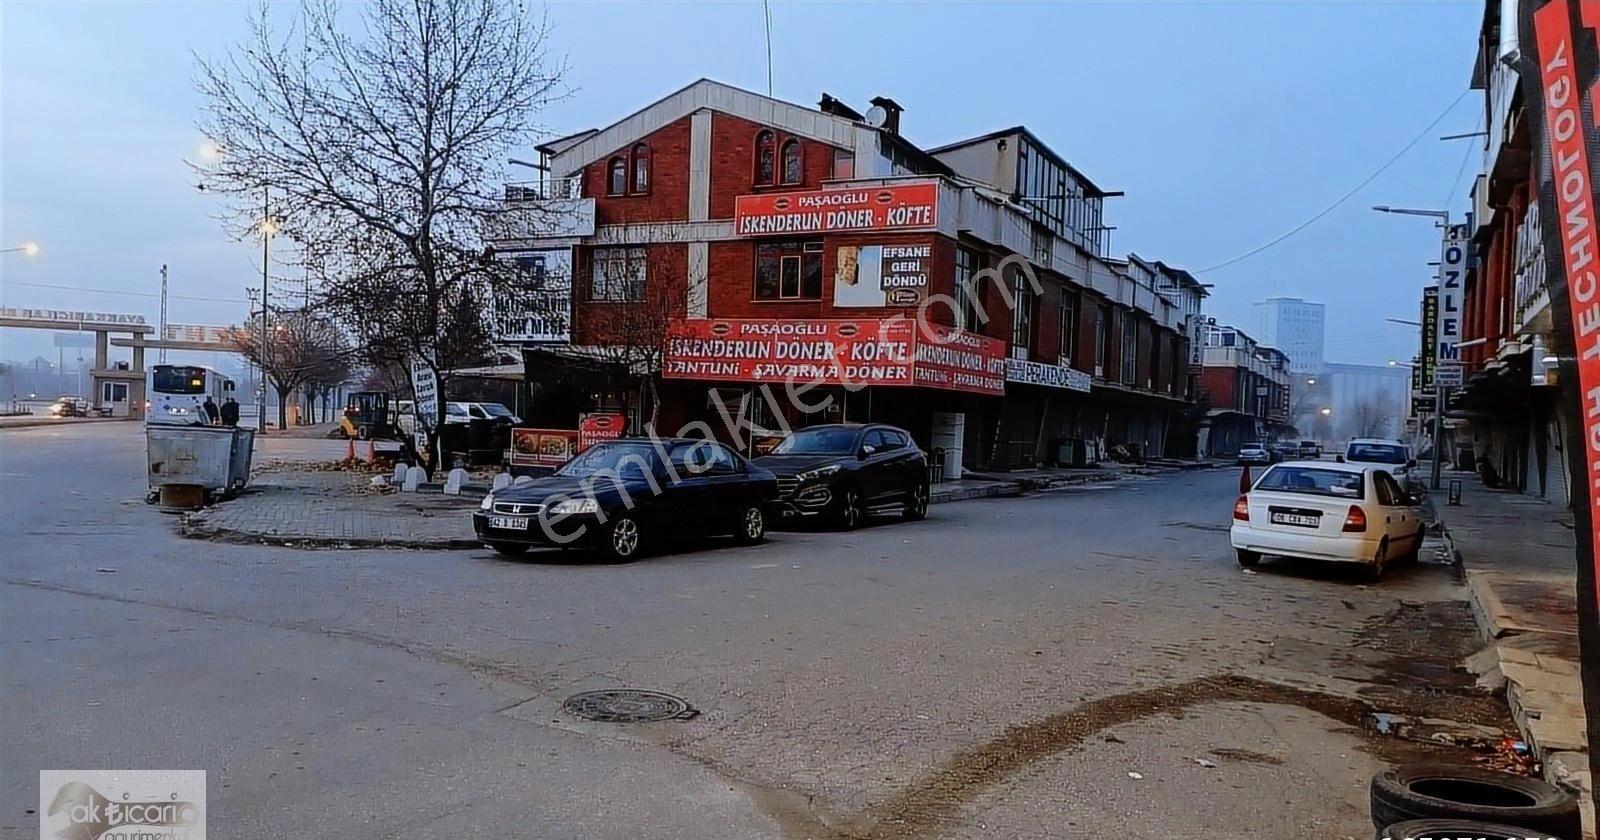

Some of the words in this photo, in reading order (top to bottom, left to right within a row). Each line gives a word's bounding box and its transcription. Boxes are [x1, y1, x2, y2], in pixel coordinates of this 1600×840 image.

[798, 192, 869, 209] PAŞAOĞLU
[740, 211, 821, 234] İSKENDERUN
[826, 206, 874, 229] DÖNER
[886, 202, 932, 226] KÖFTE
[883, 246, 931, 258] EFSANE
[891, 259, 921, 272] GERİ
[883, 274, 927, 287] DÖNDÜ
[1440, 241, 1462, 360] ÖZLEM
[741, 322, 827, 336] PAŞAOĞLU
[669, 336, 771, 359] İSKENDERUN
[776, 335, 835, 361] DÖNER
[851, 336, 907, 361] KÖFTE
[754, 363, 838, 379] ŞAVARMA
[845, 362, 907, 380] DÖNER
